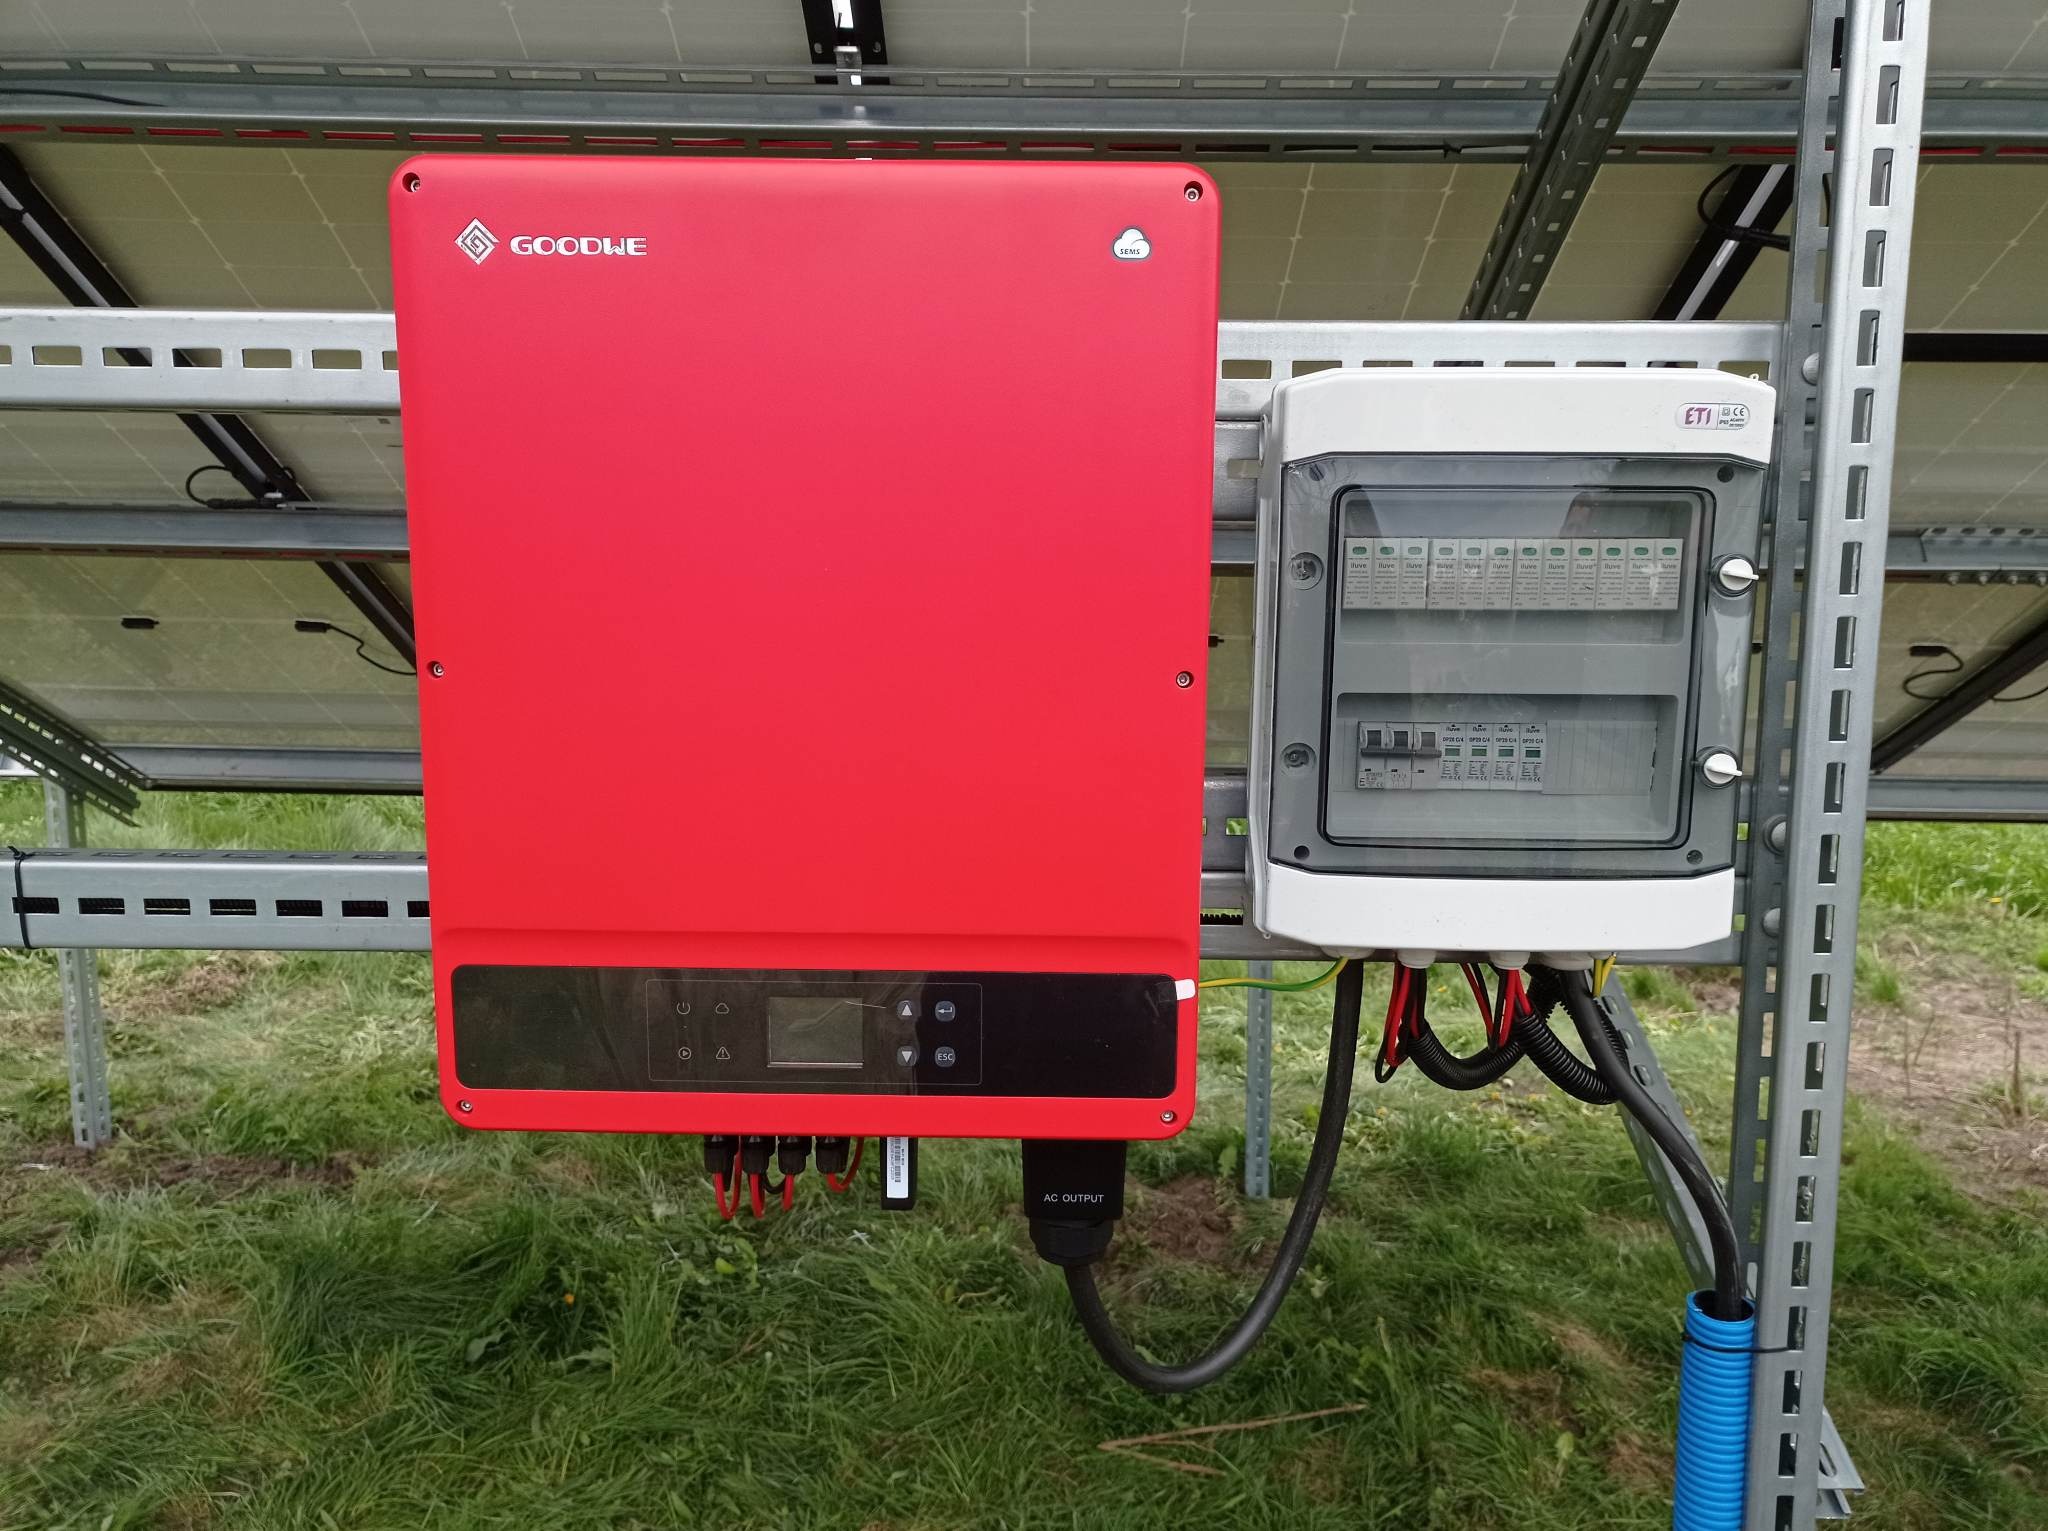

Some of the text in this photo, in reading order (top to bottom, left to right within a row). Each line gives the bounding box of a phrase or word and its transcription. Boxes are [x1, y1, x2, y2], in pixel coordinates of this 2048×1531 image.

[509, 235, 648, 257] GOODWE
[1684, 407, 1712, 425] ETI
[937, 1052, 953, 1062] ESC
[1043, 1193, 1104, 1203] AC OUTPUT
